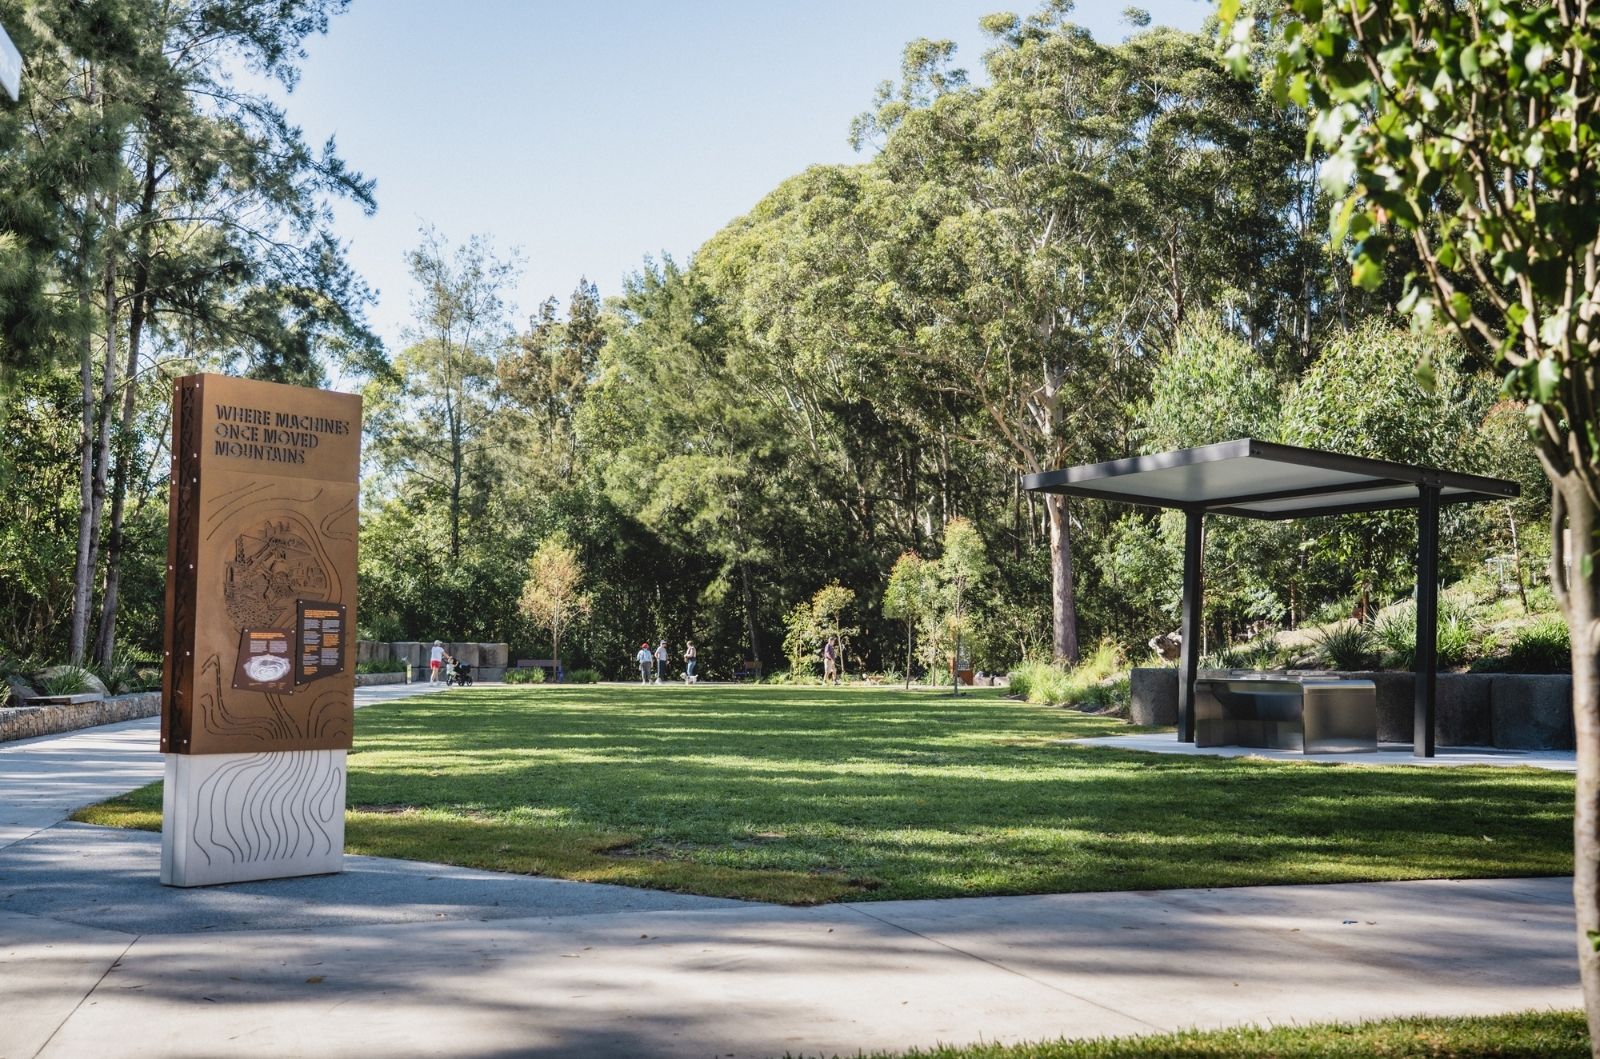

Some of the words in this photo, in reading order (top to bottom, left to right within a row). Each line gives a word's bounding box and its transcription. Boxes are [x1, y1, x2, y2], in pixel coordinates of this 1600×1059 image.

[215, 404, 271, 426] WHERE
[275, 412, 350, 436] MACHINES
[215, 422, 259, 442] ONCE
[263, 428, 319, 449] MOVED
[215, 440, 305, 465] MOUNTAINS
